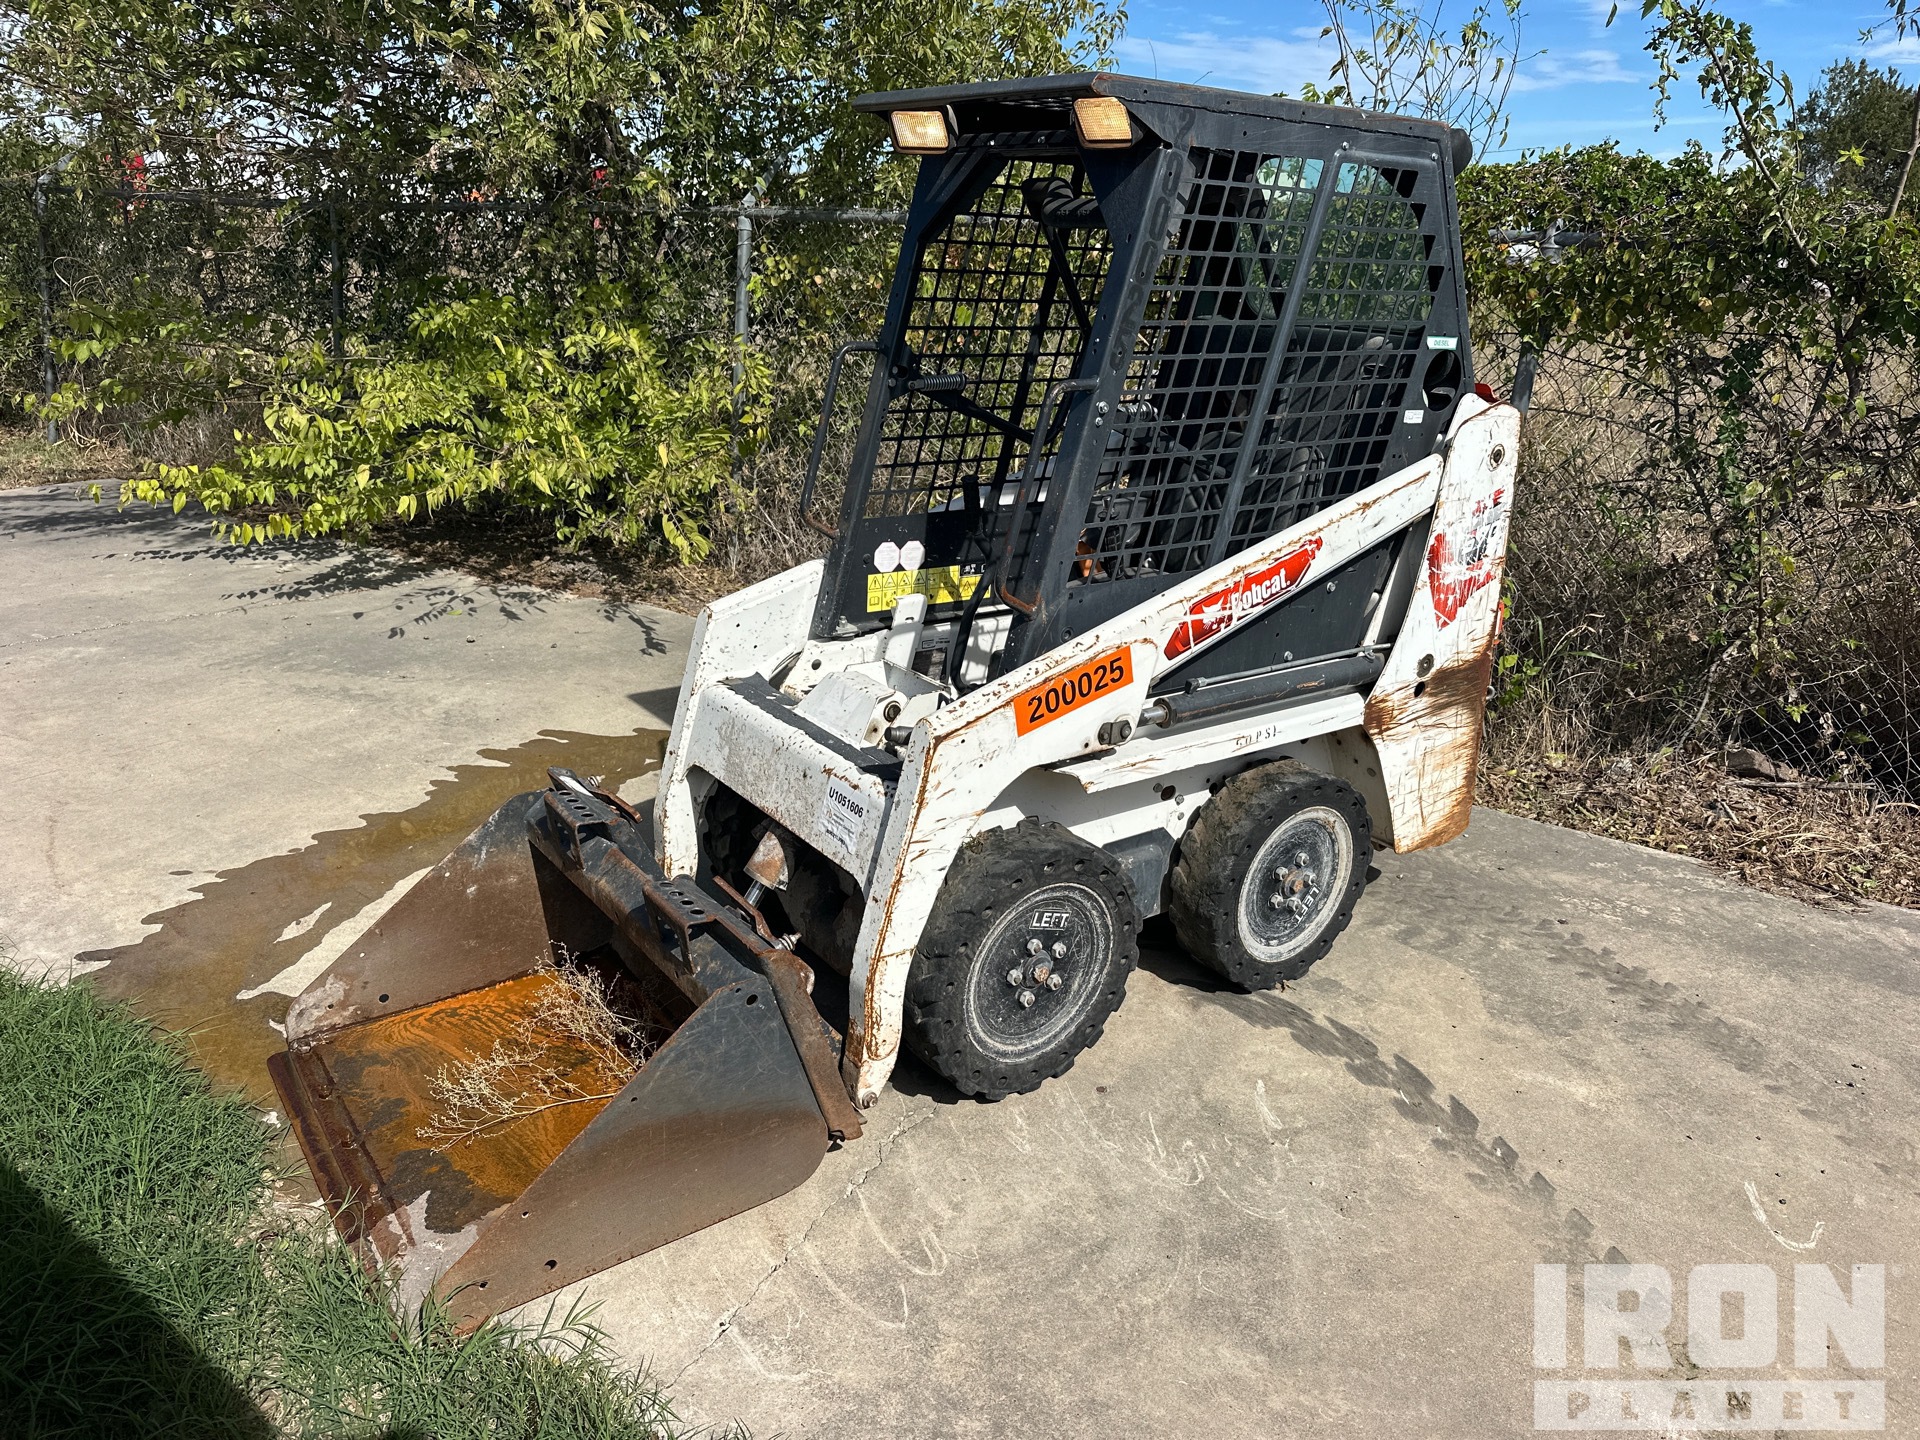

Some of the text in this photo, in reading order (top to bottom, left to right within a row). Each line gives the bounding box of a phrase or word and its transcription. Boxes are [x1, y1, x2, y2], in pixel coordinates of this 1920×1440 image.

[1028, 656, 1124, 724] 200025
[829, 786, 864, 818] U1051606
[1032, 912, 1070, 928] LEFT
[1295, 886, 1320, 924] LEFT
